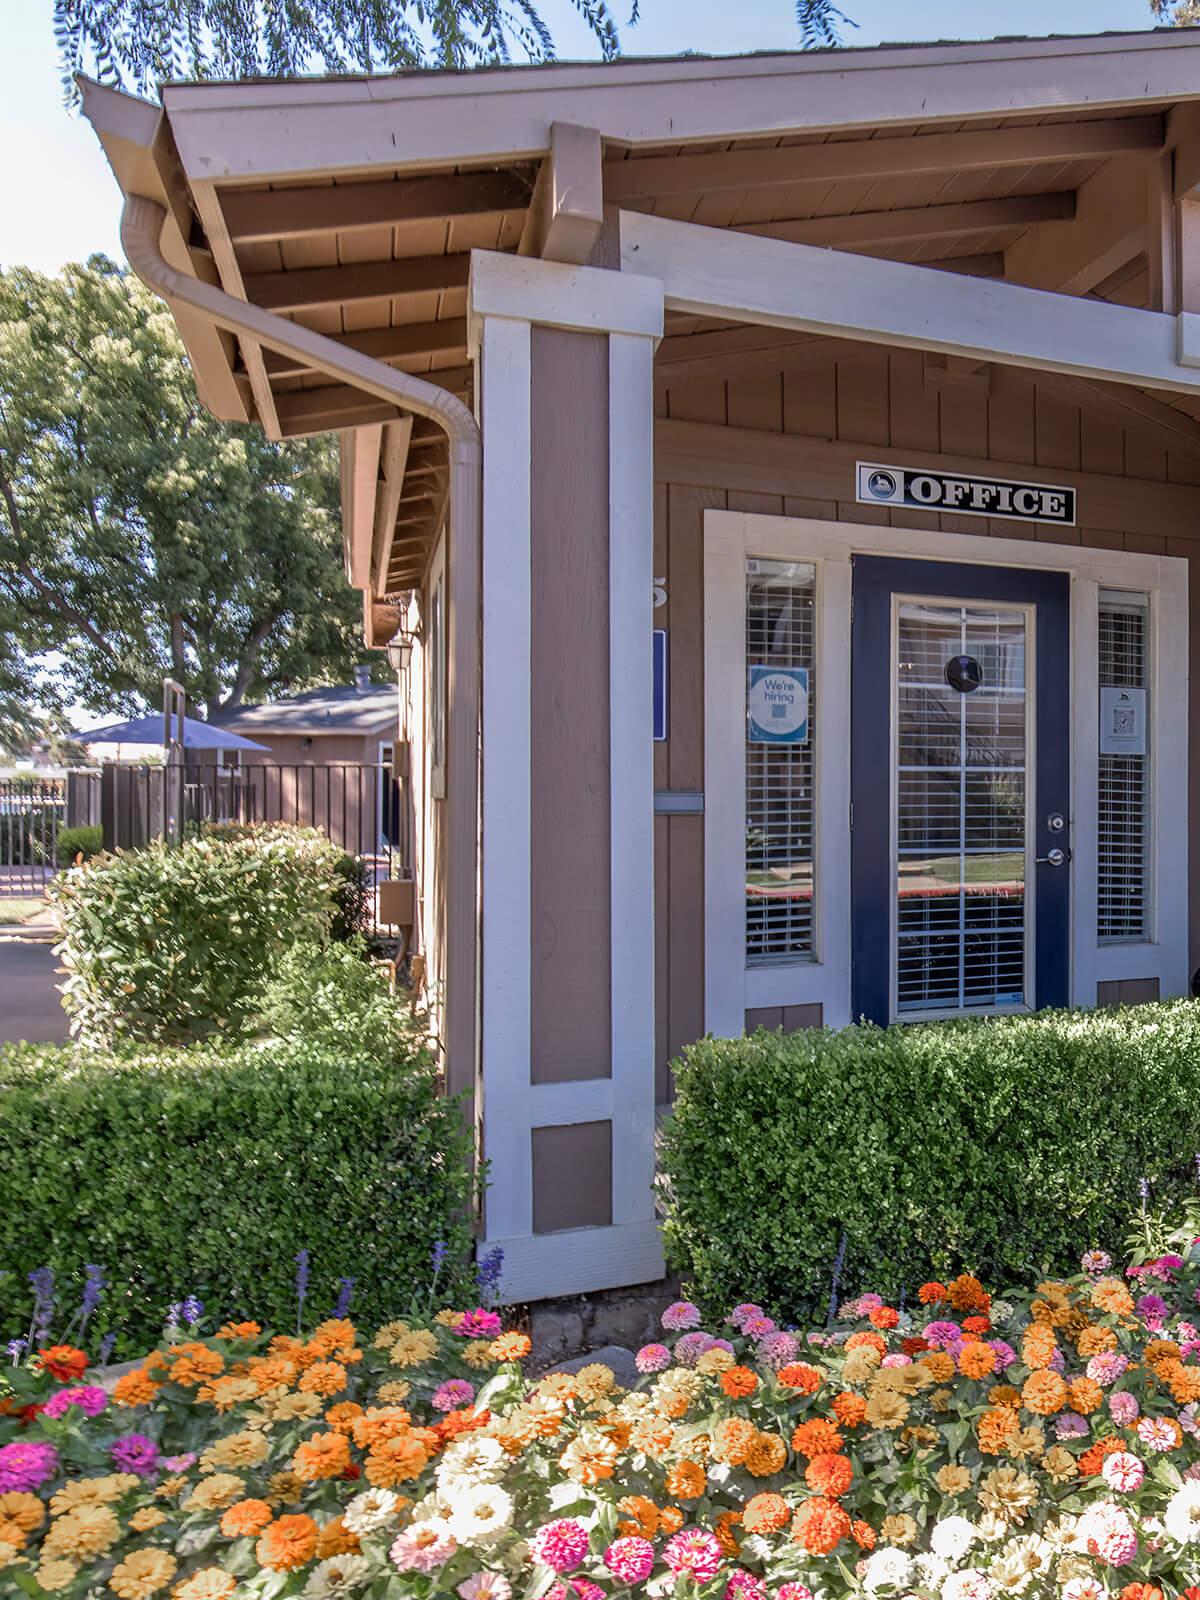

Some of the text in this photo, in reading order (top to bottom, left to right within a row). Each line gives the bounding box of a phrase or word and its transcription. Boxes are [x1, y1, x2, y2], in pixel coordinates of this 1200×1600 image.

[910, 476, 1066, 517] OFFICE
[764, 680, 795, 691] We're
[764, 691, 794, 704] hiring
